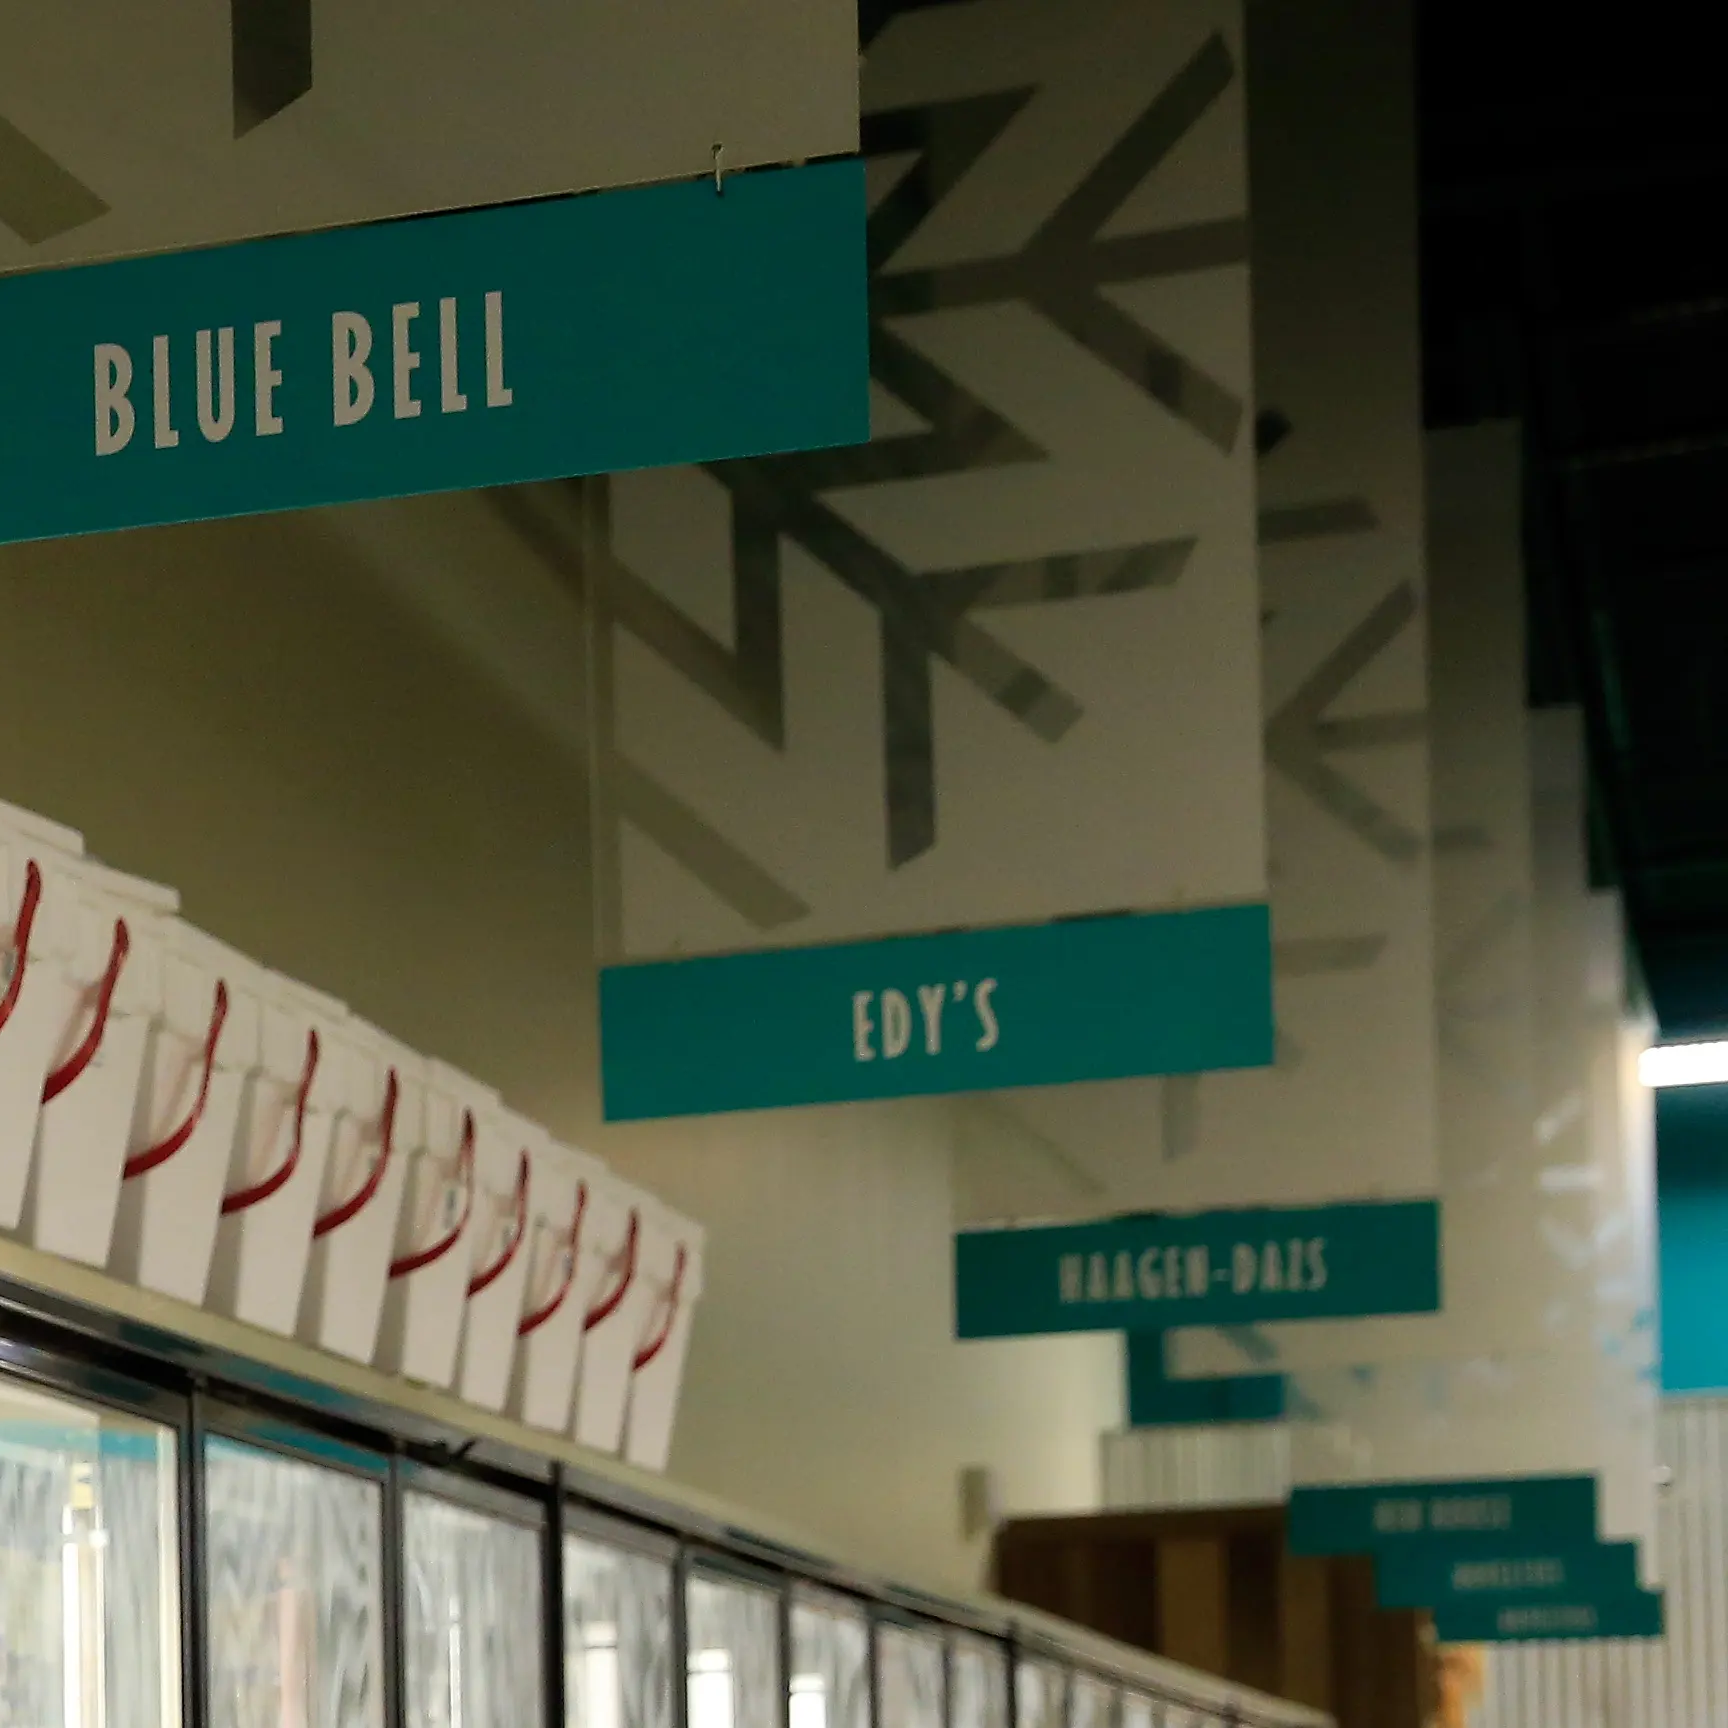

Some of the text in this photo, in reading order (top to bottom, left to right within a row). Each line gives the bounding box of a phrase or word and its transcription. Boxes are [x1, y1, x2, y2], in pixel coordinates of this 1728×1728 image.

[93, 290, 515, 457] BLUE BELL
[852, 977, 999, 1062] EDY'S
